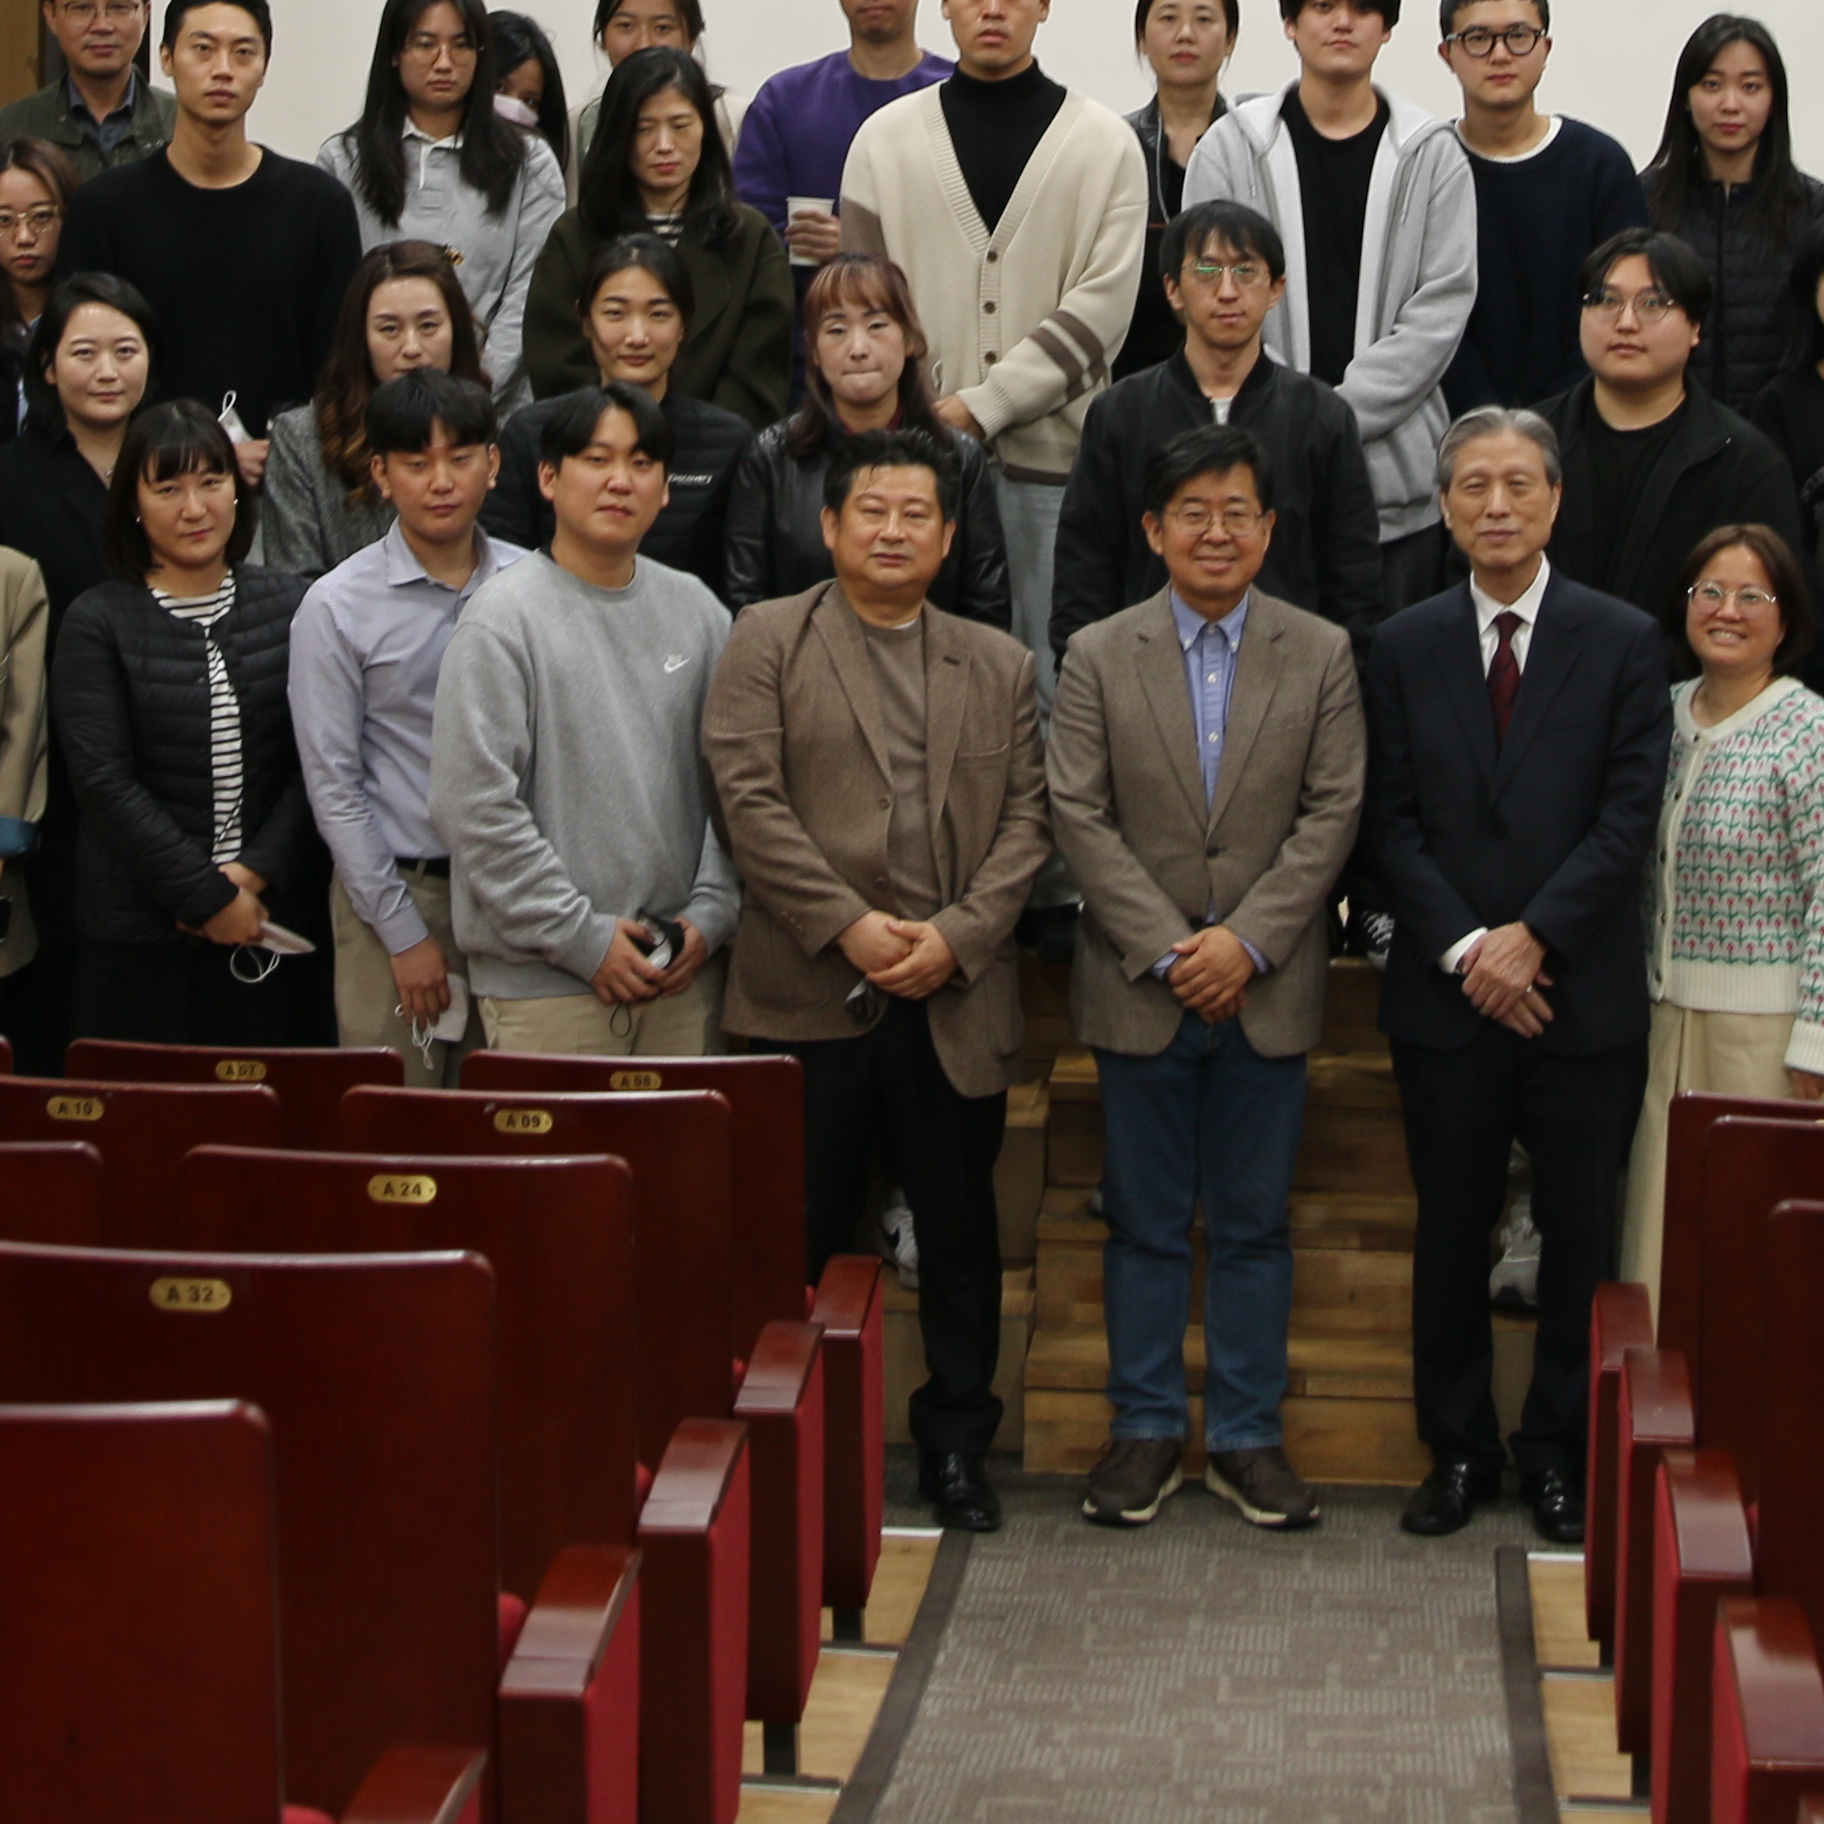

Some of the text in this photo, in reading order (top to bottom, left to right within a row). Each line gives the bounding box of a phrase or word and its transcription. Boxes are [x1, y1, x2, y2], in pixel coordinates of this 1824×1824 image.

[58, 1101, 93, 1115] A 10
[506, 1114, 540, 1128] A 09
[383, 1182, 422, 1196] A 24
[167, 1286, 213, 1303] A 32
